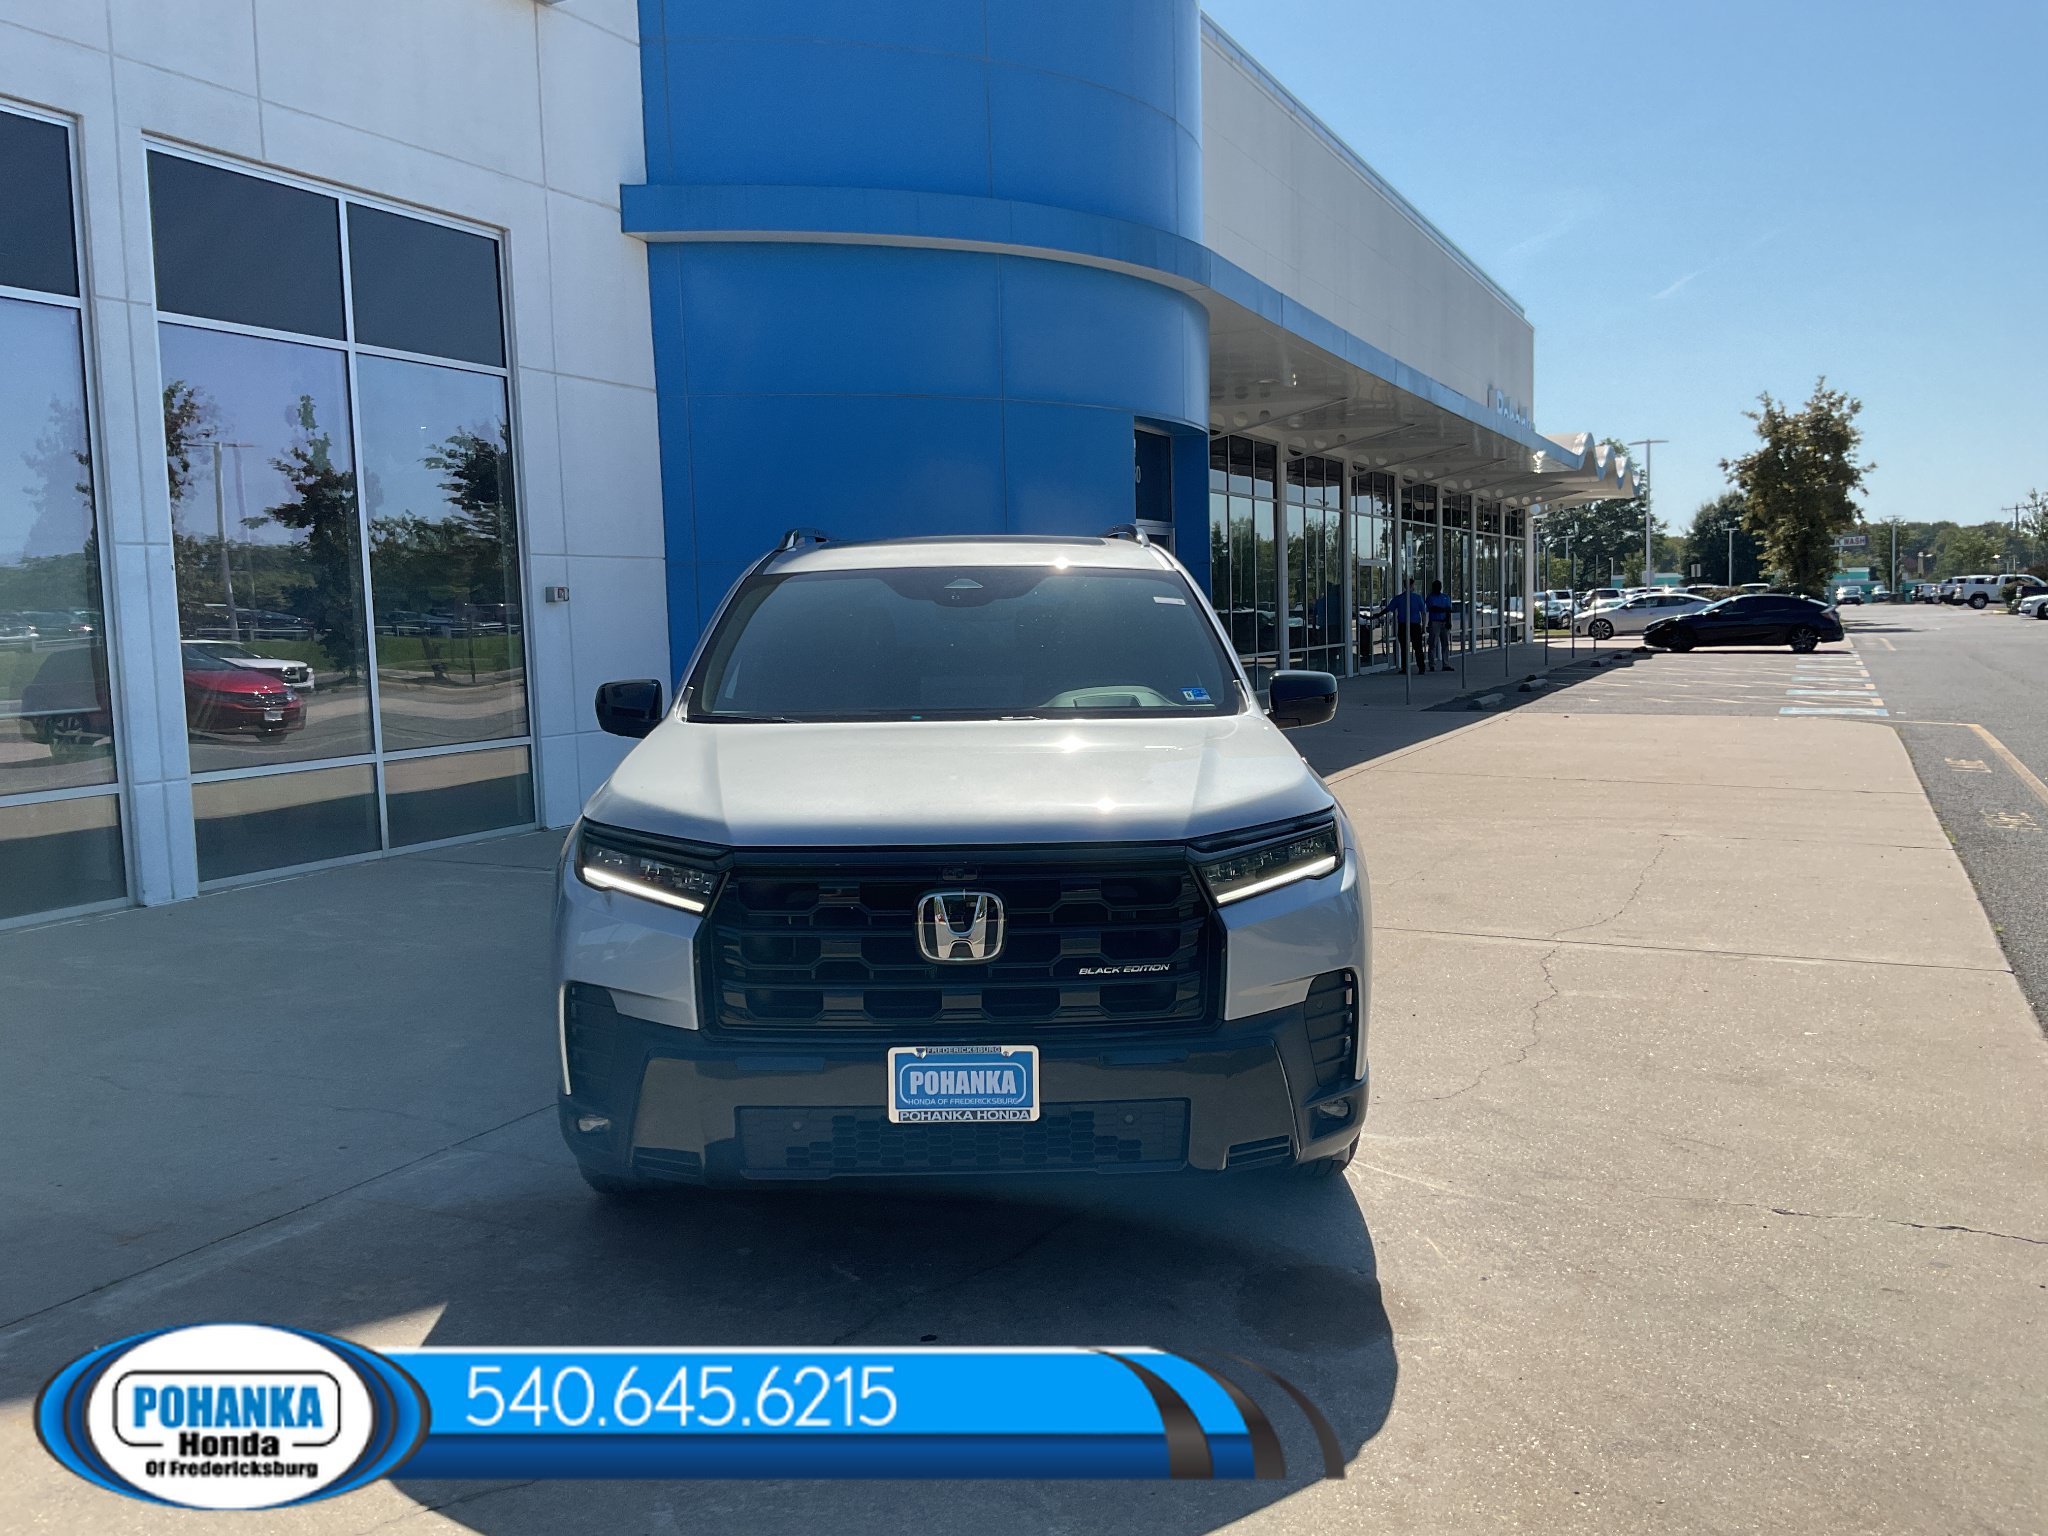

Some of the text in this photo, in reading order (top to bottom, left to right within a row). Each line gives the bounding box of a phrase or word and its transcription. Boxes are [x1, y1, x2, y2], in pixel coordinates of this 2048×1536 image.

[1078, 963, 1171, 975] BLACK EDITION
[926, 1046, 1002, 1054] FREDERICKSBURG
[909, 1070, 1017, 1096] POHANKA
[949, 1097, 1018, 1105] FREDERICKSBURG
[900, 1109, 1031, 1122] POHANKA HONDA
